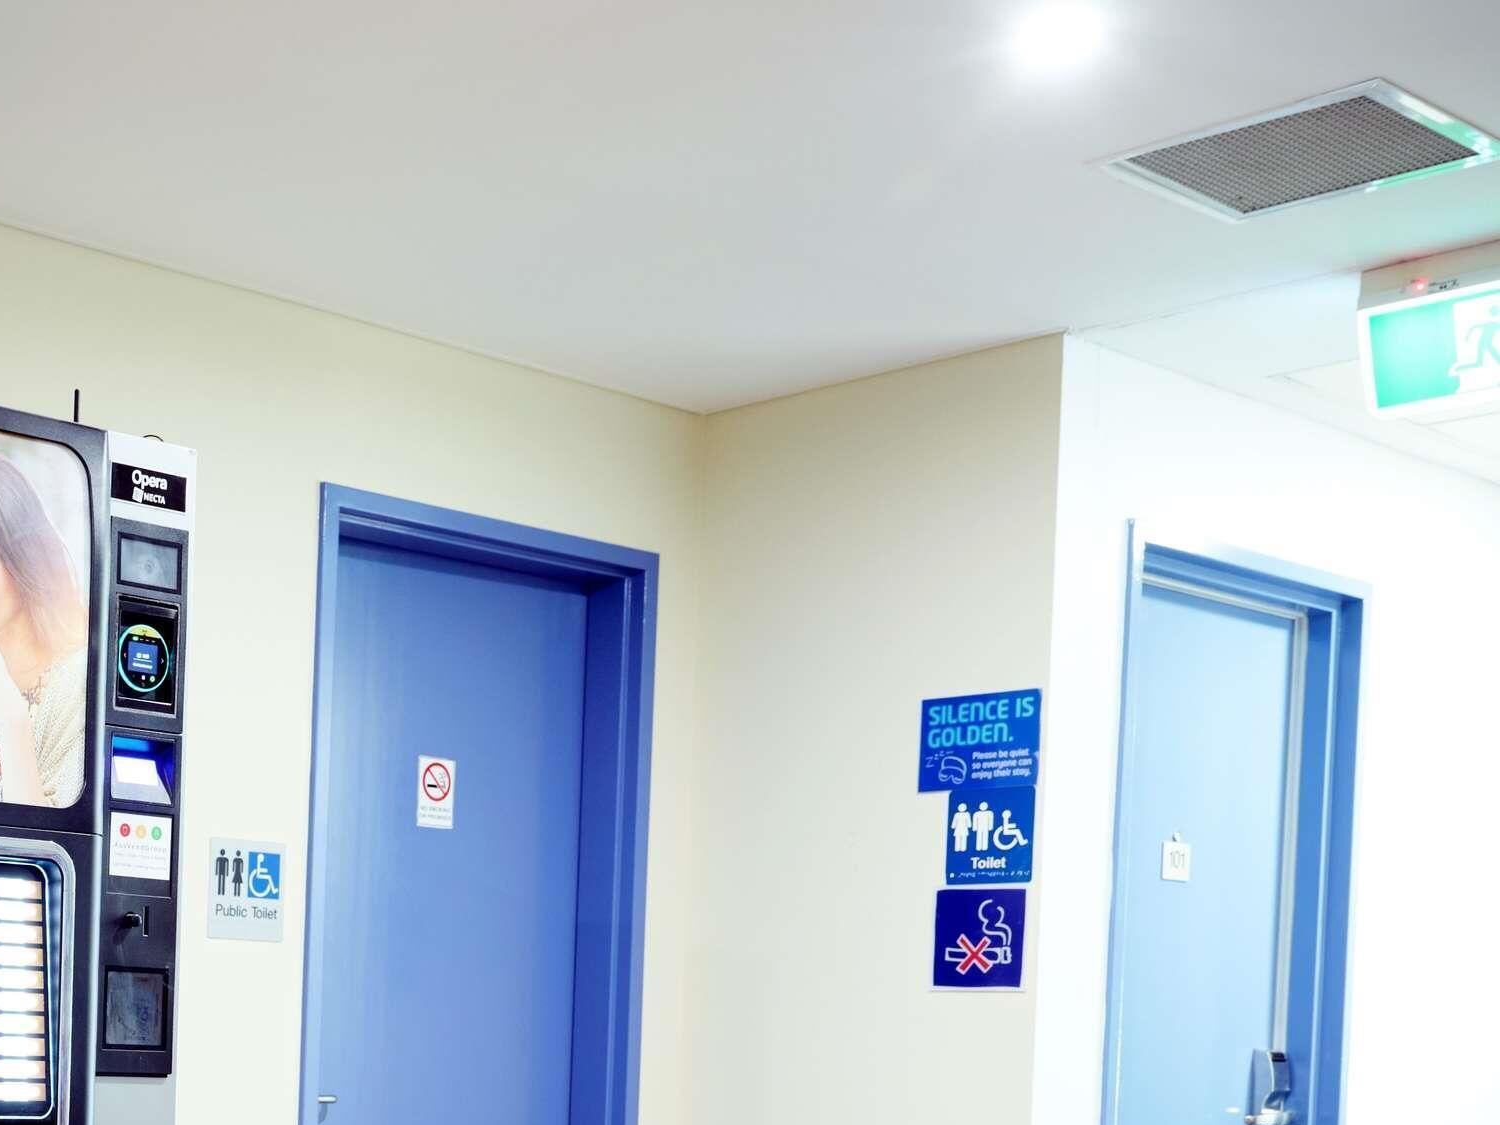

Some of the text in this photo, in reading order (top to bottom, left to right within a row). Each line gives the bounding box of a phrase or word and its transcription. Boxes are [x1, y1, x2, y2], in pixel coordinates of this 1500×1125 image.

[131, 469, 168, 491] Opera
[928, 696, 1035, 726] SILENCE IS
[972, 748, 1029, 760] Please be quiet
[972, 758, 1032, 770] so everyone can
[971, 770, 993, 780] enjoy
[993, 768, 1011, 777] their
[970, 856, 1007, 869] Toilet
[215, 903, 278, 919] Public Toilet
